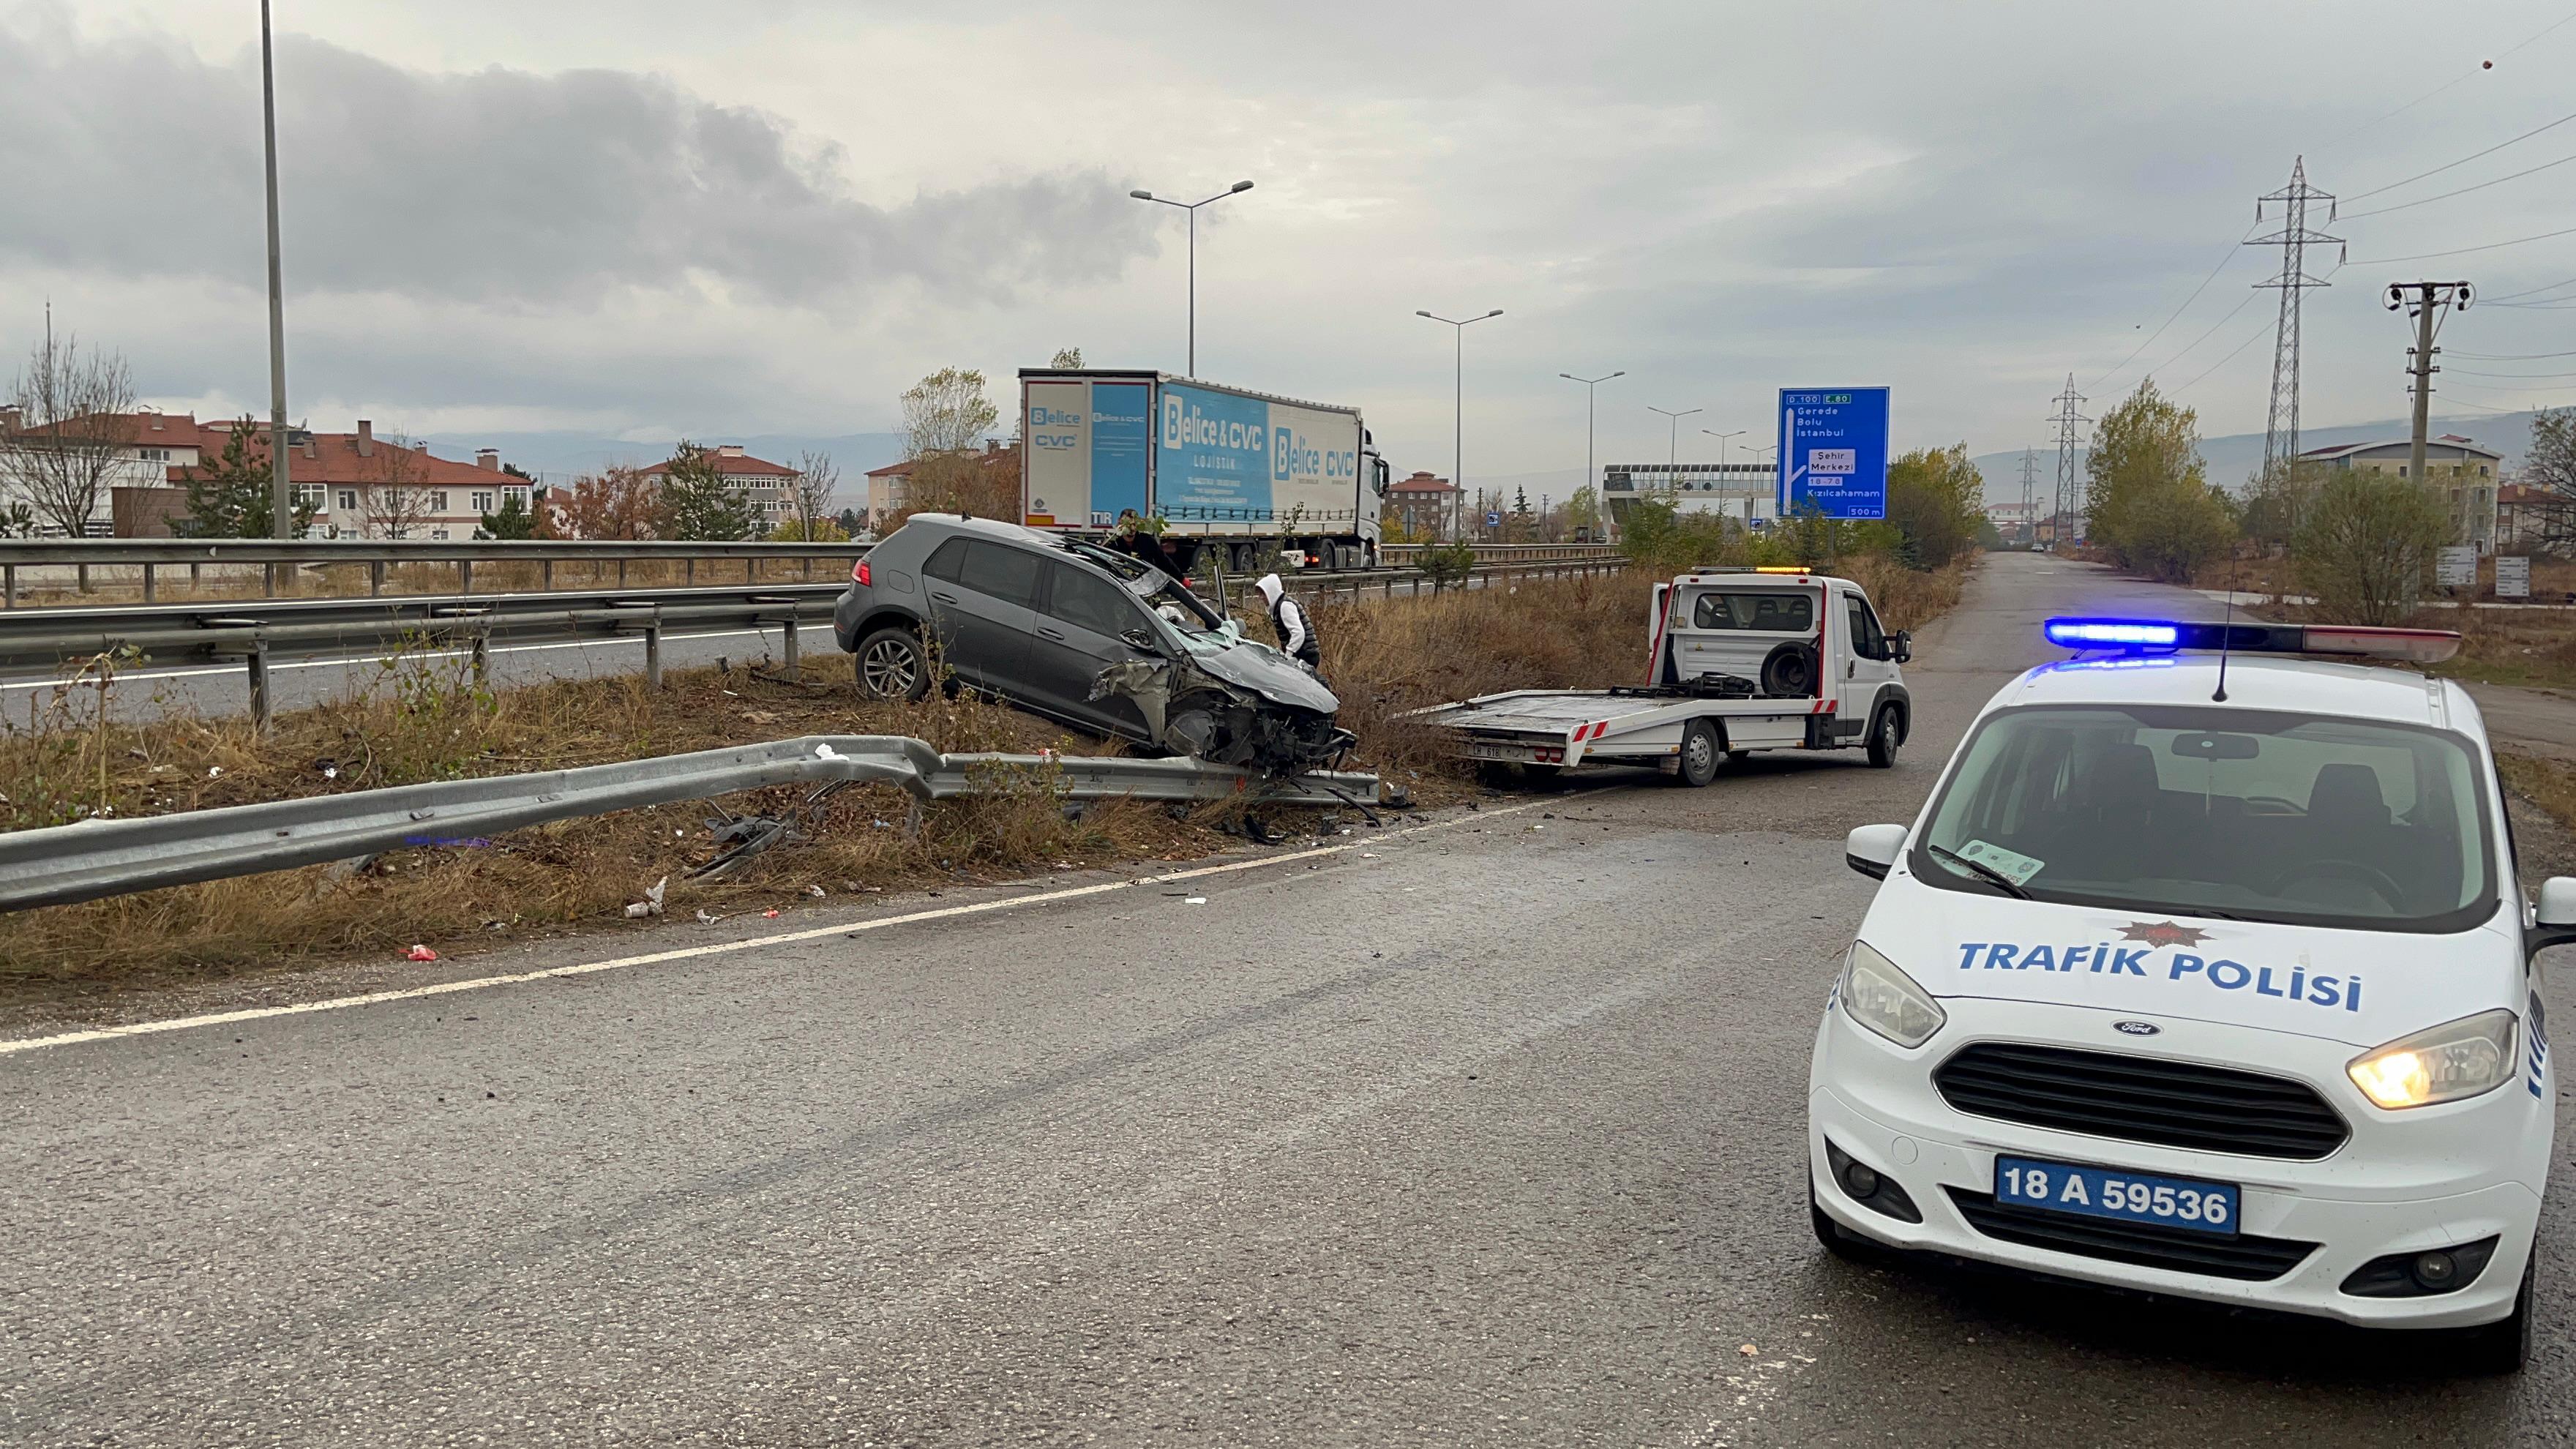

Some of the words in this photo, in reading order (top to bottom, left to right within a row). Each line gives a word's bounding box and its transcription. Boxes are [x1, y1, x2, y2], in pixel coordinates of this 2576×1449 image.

[1030, 407, 1081, 425] Belice
[1797, 407, 1838, 415] Gerede
[1164, 394, 1217, 449] Belice
[1219, 419, 1227, 447] &
[1229, 422, 1262, 452] CVC
[1797, 418, 1822, 426] Bolu
[1797, 427, 1844, 437] İstanbul
[1035, 435, 1076, 447] CVC
[1274, 427, 1320, 481] Belice
[1326, 450, 1355, 476] CVC
[1817, 452, 1845, 460] Şehir
[1811, 463, 1854, 471] Merkezi
[1807, 489, 1881, 498] Kızılcahamam
[1850, 508, 1870, 516] 500
[1091, 512, 1112, 525] TIR
[1958, 942, 2149, 977] TRAFİK
[2168, 953, 2362, 1013] POLİSİ
[2121, 1022, 2152, 1033] Ford
[2004, 1167, 2048, 1199] 18
[2059, 1174, 2091, 1206] A
[2101, 1180, 2228, 1224] 59536
